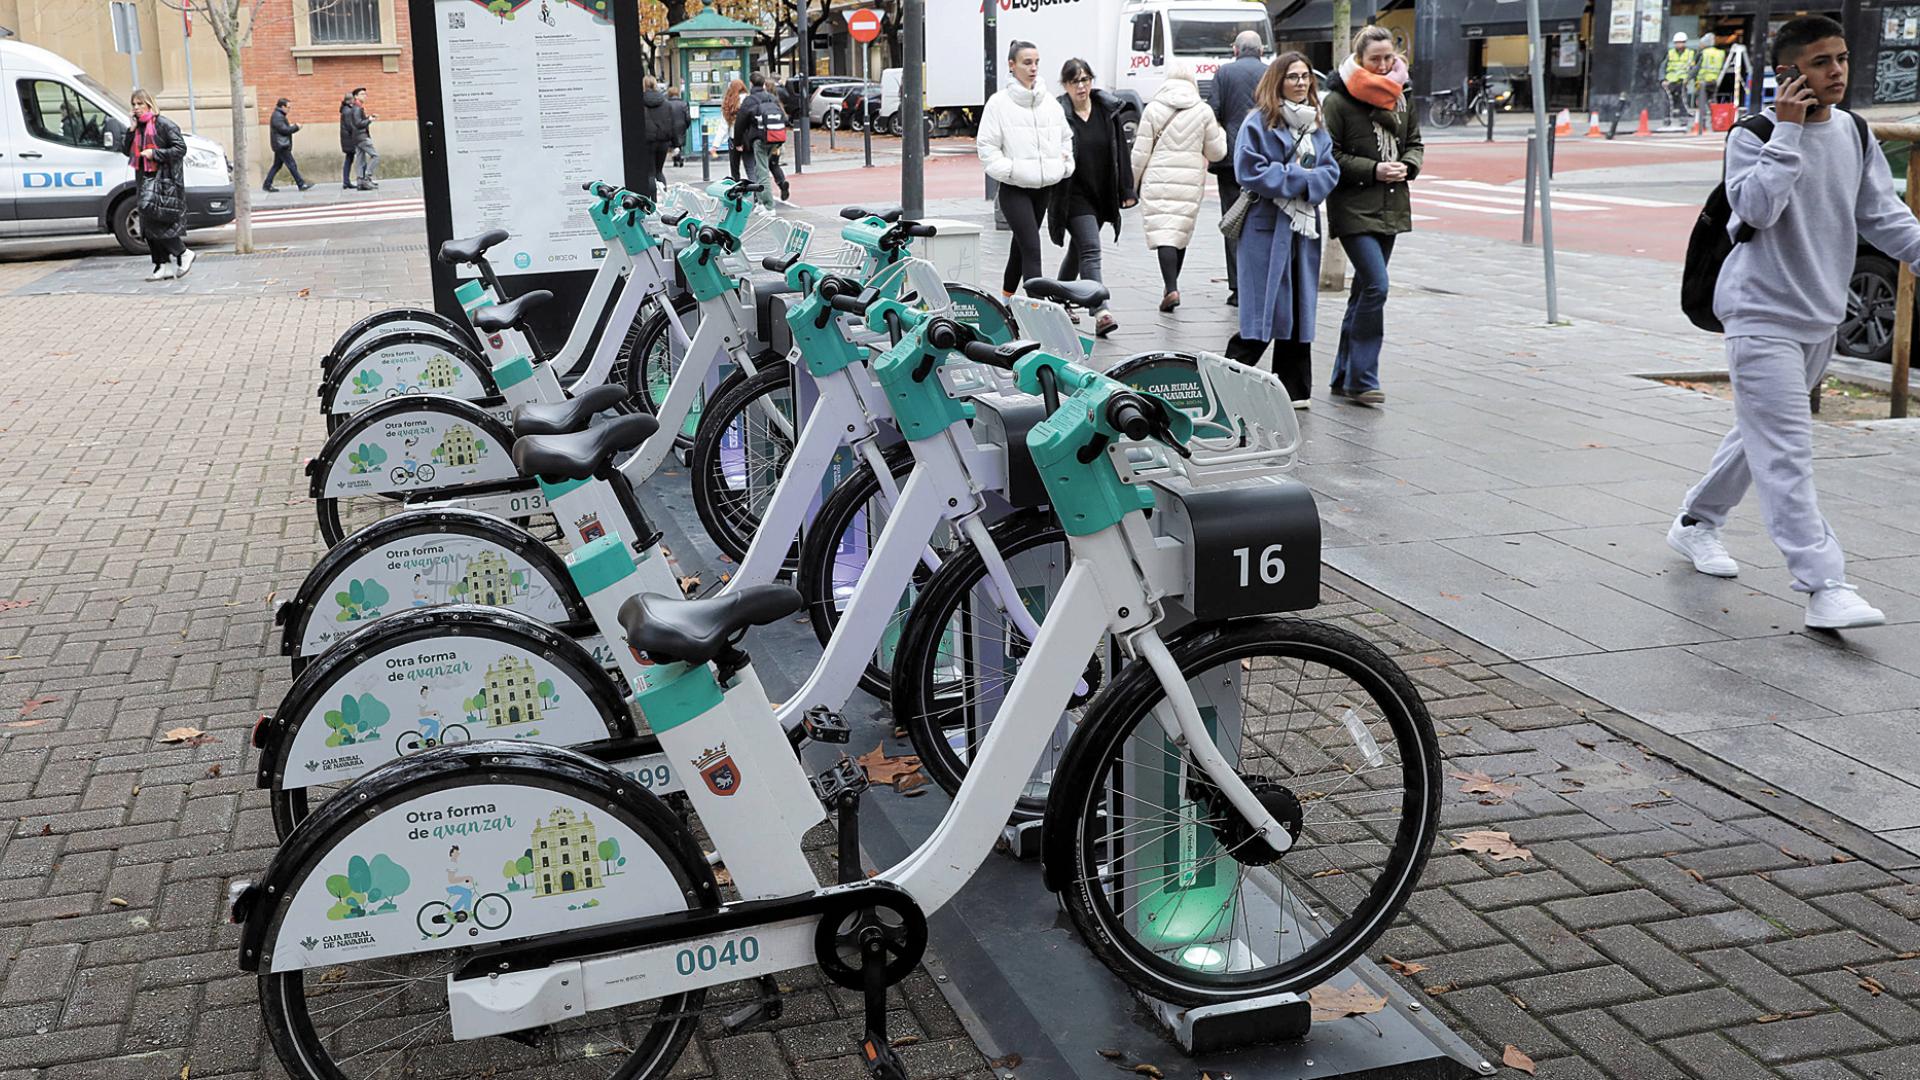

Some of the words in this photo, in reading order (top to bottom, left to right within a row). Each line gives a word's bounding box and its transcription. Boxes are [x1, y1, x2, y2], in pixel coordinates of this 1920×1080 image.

[1130, 56, 1150, 69] XPO
[22, 171, 104, 188] DIGI
[1149, 385, 1170, 394] CAJA
[1171, 382, 1201, 392] RURAL
[1163, 391, 1204, 401] NAVARRA
[397, 426, 436, 438] avanzar
[404, 420, 427, 428] forma
[386, 550, 410, 559] Otra
[412, 545, 444, 555] forma
[387, 562, 402, 570] de
[403, 553, 456, 570] avanzar
[1233, 544, 1286, 587] 16
[386, 657, 415, 669] Otra
[417, 651, 457, 664] forma
[388, 672, 405, 682] de
[407, 660, 473, 681] avanzar
[406, 811, 443, 824] Otra
[446, 803, 497, 819] forma
[408, 828, 430, 840] de
[432, 814, 517, 840] avanzar
[322, 934, 343, 943] CAJA
[343, 930, 372, 940] RURAL
[336, 936, 376, 948] NAVARRA
[1095, 925, 1111, 945] CST
[676, 936, 760, 976] 0040
